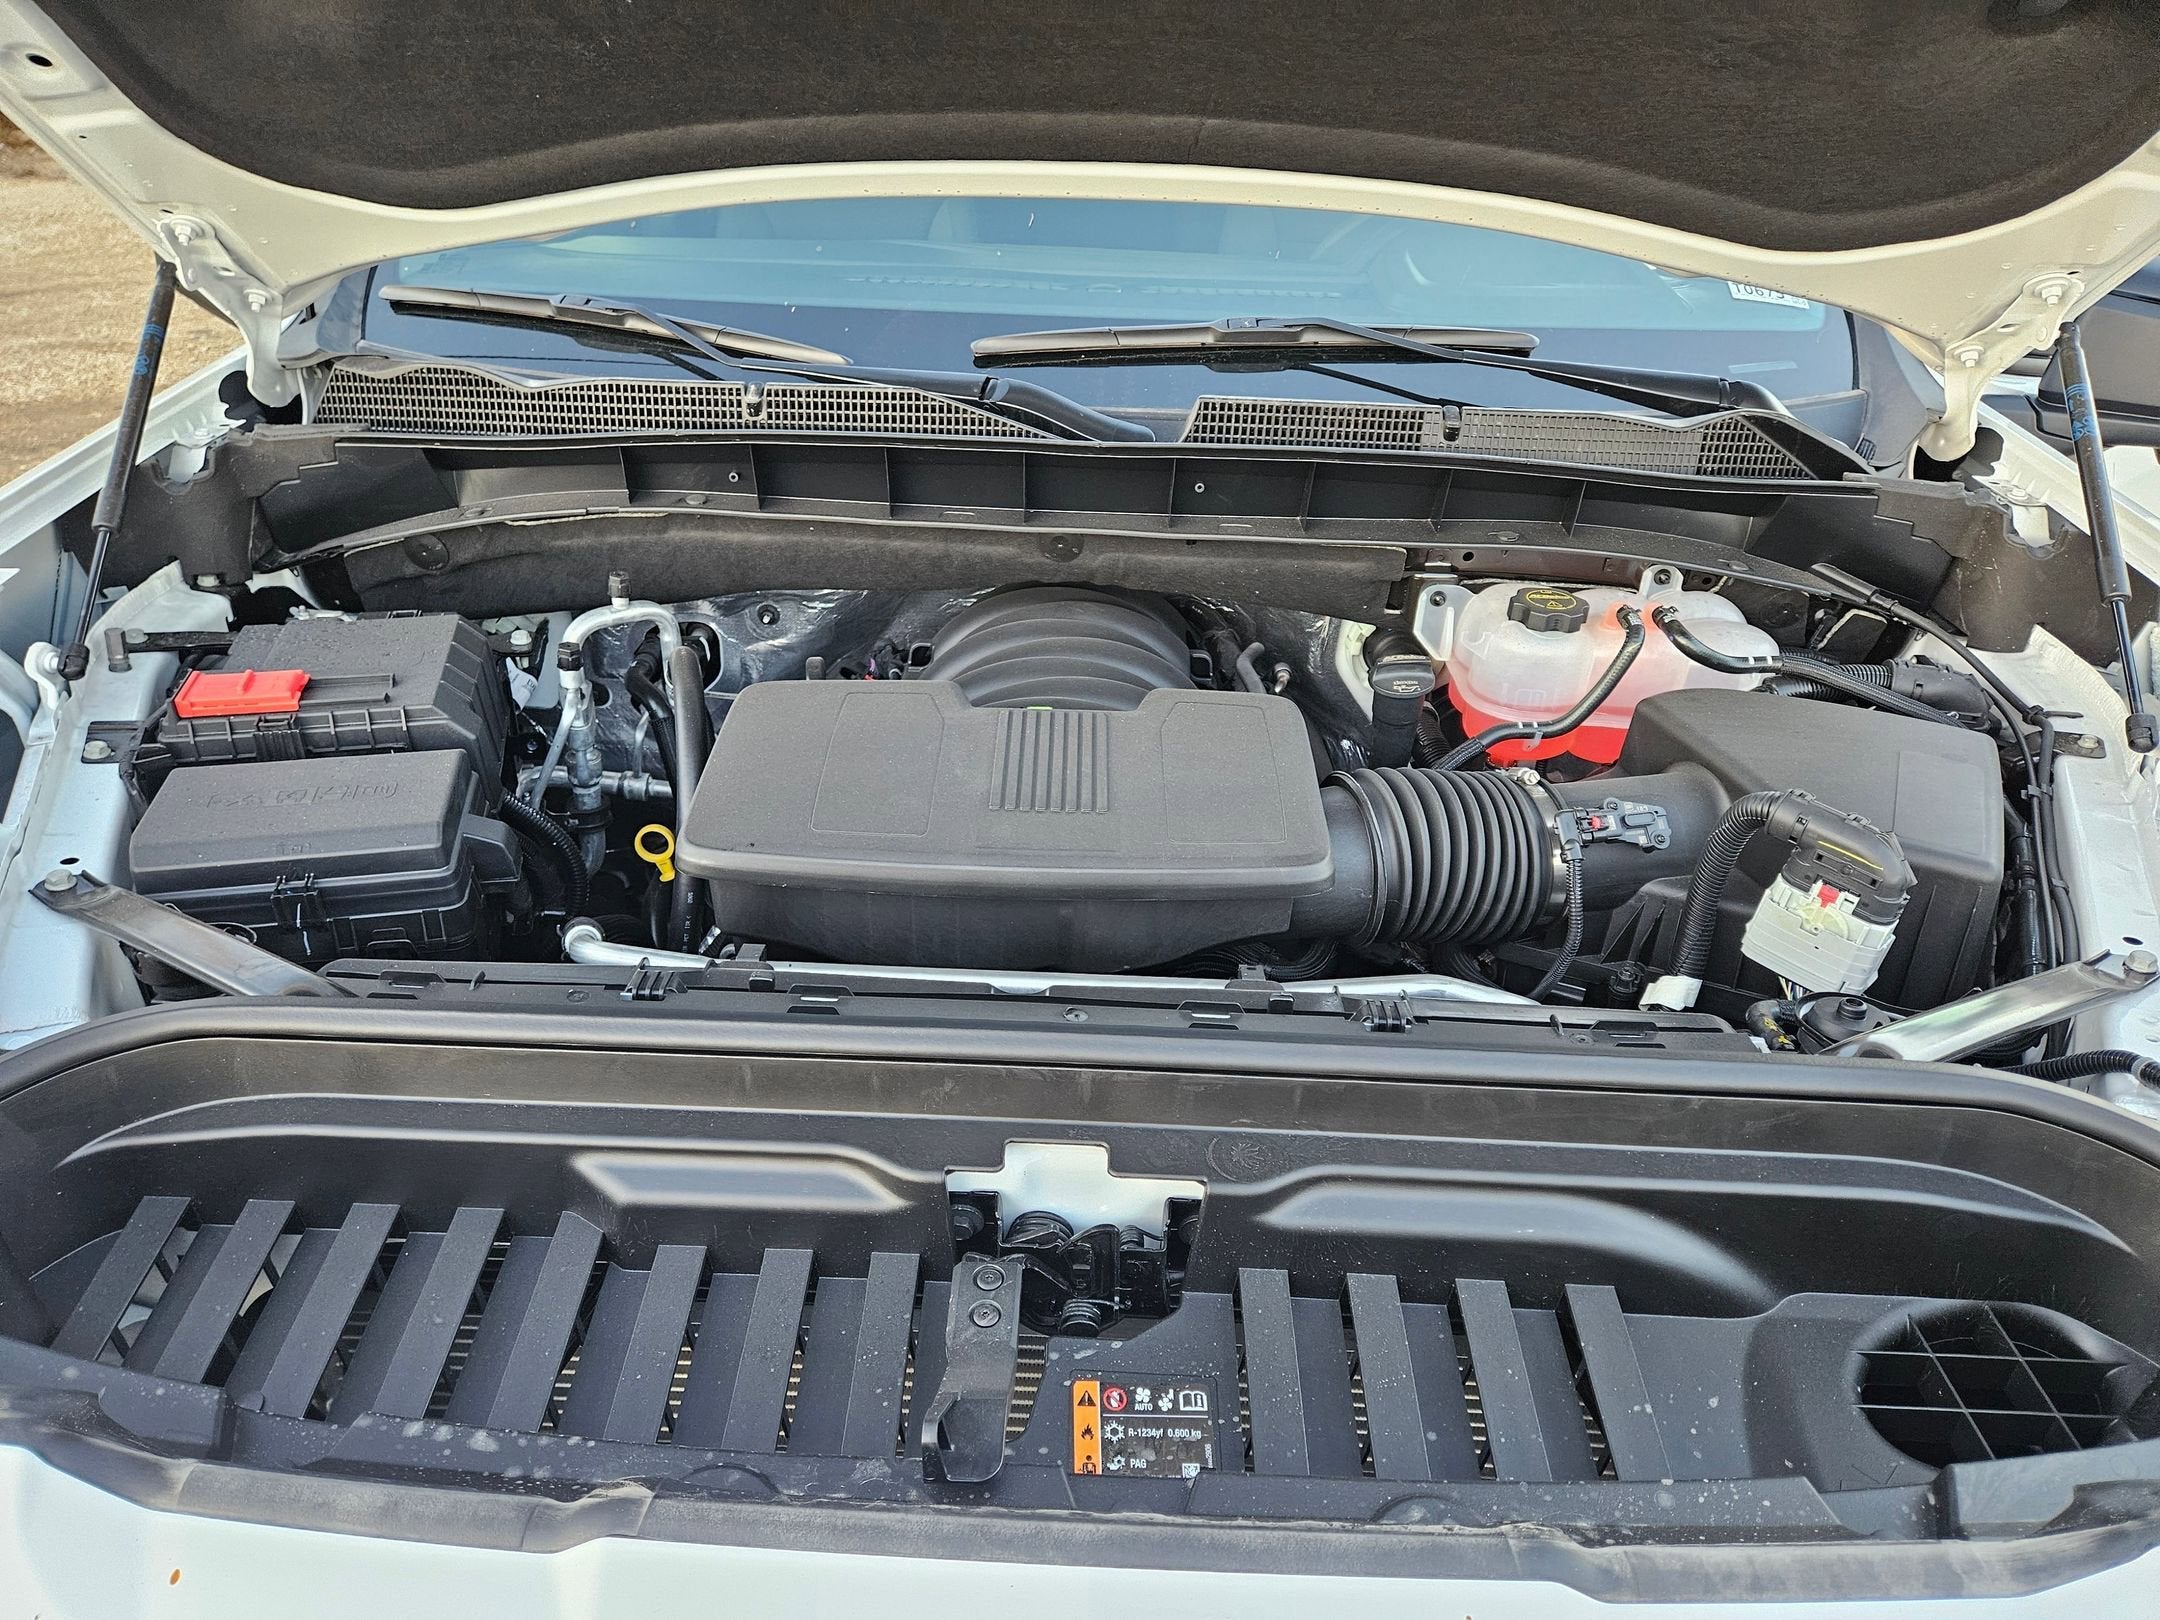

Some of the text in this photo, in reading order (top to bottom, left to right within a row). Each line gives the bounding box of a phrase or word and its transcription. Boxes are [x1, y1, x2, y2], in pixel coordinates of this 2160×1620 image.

[1134, 1403, 1153, 1411] AUTO
[1128, 1427, 1202, 1440] R-1234yf 0.600 kg
[1130, 1459, 1147, 1469] PAG
